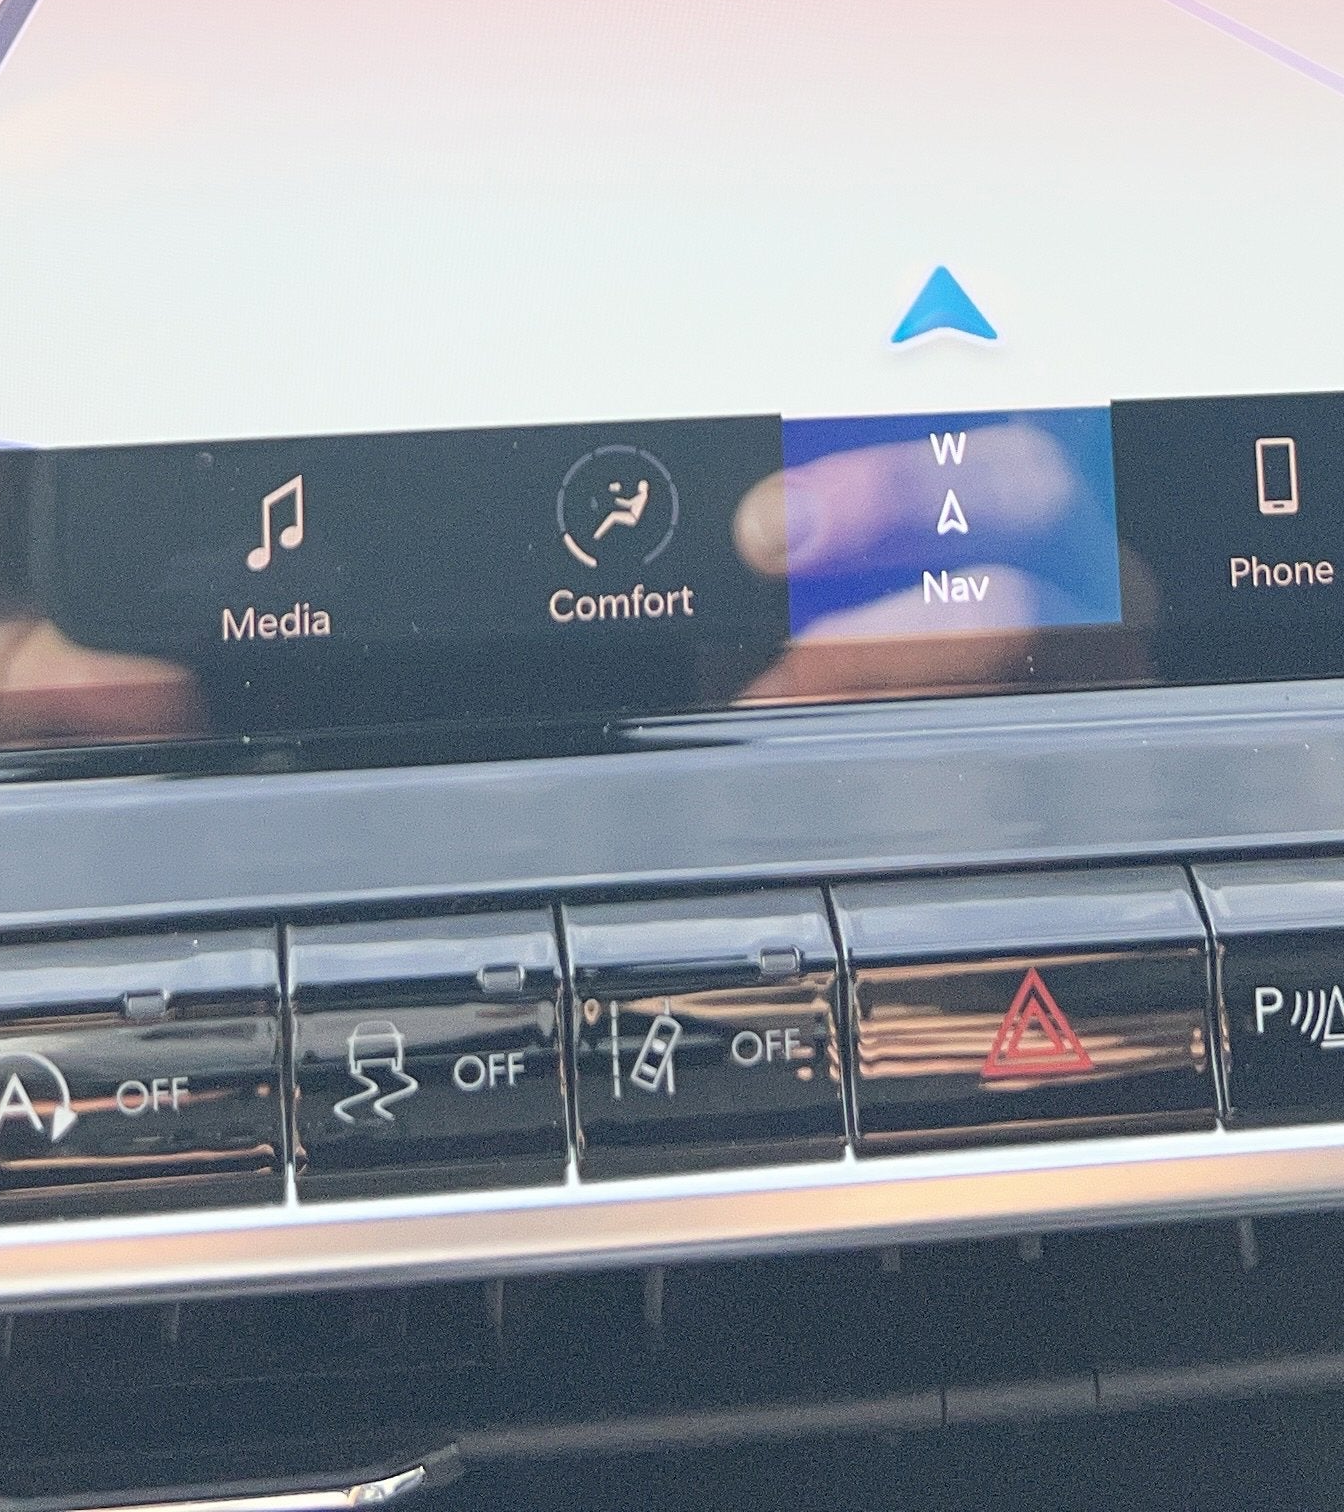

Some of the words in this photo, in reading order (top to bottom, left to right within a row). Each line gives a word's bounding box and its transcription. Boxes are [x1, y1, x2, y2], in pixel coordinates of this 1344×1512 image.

[928, 431, 968, 467] W
[921, 569, 990, 605] Nav
[1229, 553, 1335, 589] Phone
[221, 601, 333, 641] Media
[548, 581, 695, 622] Comfort
[1256, 986, 1285, 1034] P
[731, 1027, 802, 1067] OFF
[453, 1050, 526, 1090] OFF
[116, 1075, 190, 1116] OFF
